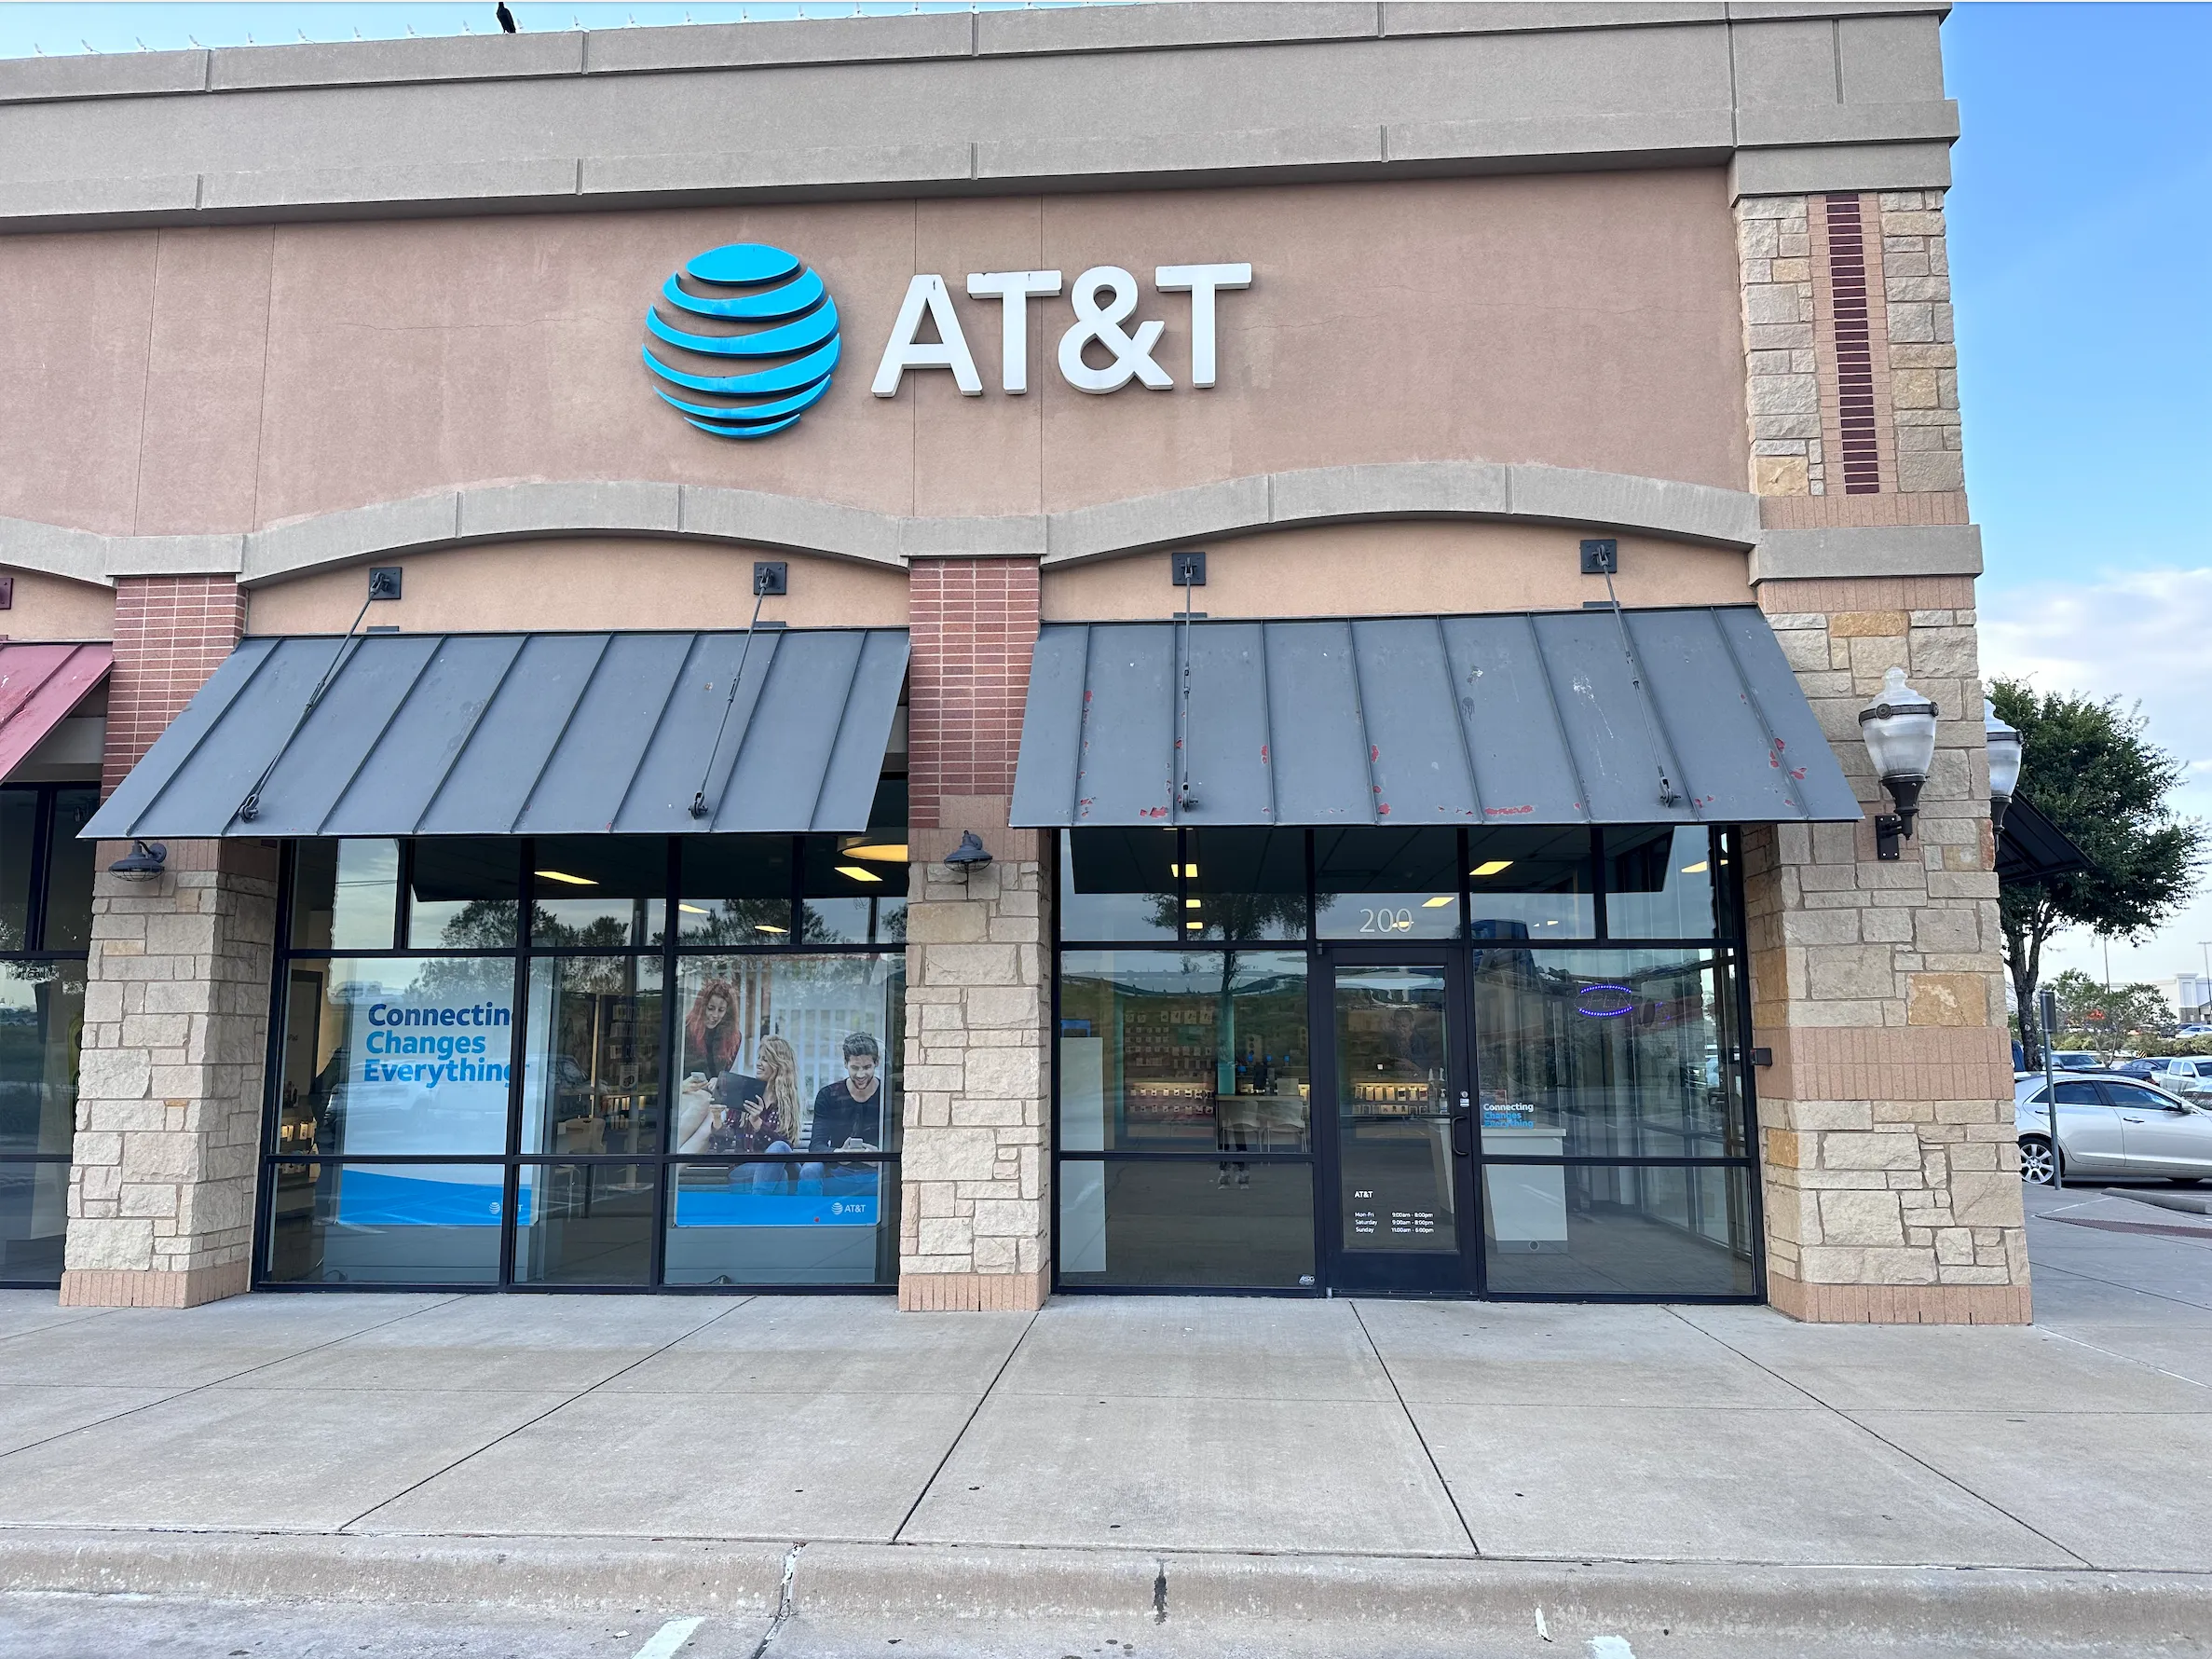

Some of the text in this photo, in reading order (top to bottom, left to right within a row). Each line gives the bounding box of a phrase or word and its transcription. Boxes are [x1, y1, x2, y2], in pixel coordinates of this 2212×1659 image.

[870, 262, 1252, 398] AT&T
[1359, 908, 1413, 933] 200
[368, 1001, 512, 1026] Connectin
[365, 1030, 486, 1061] Changes
[1482, 1103, 1535, 1113] Connecting
[1484, 1111, 1522, 1119] Changes
[1484, 1119, 1534, 1129] Everything
[844, 1204, 867, 1213] AT&T
